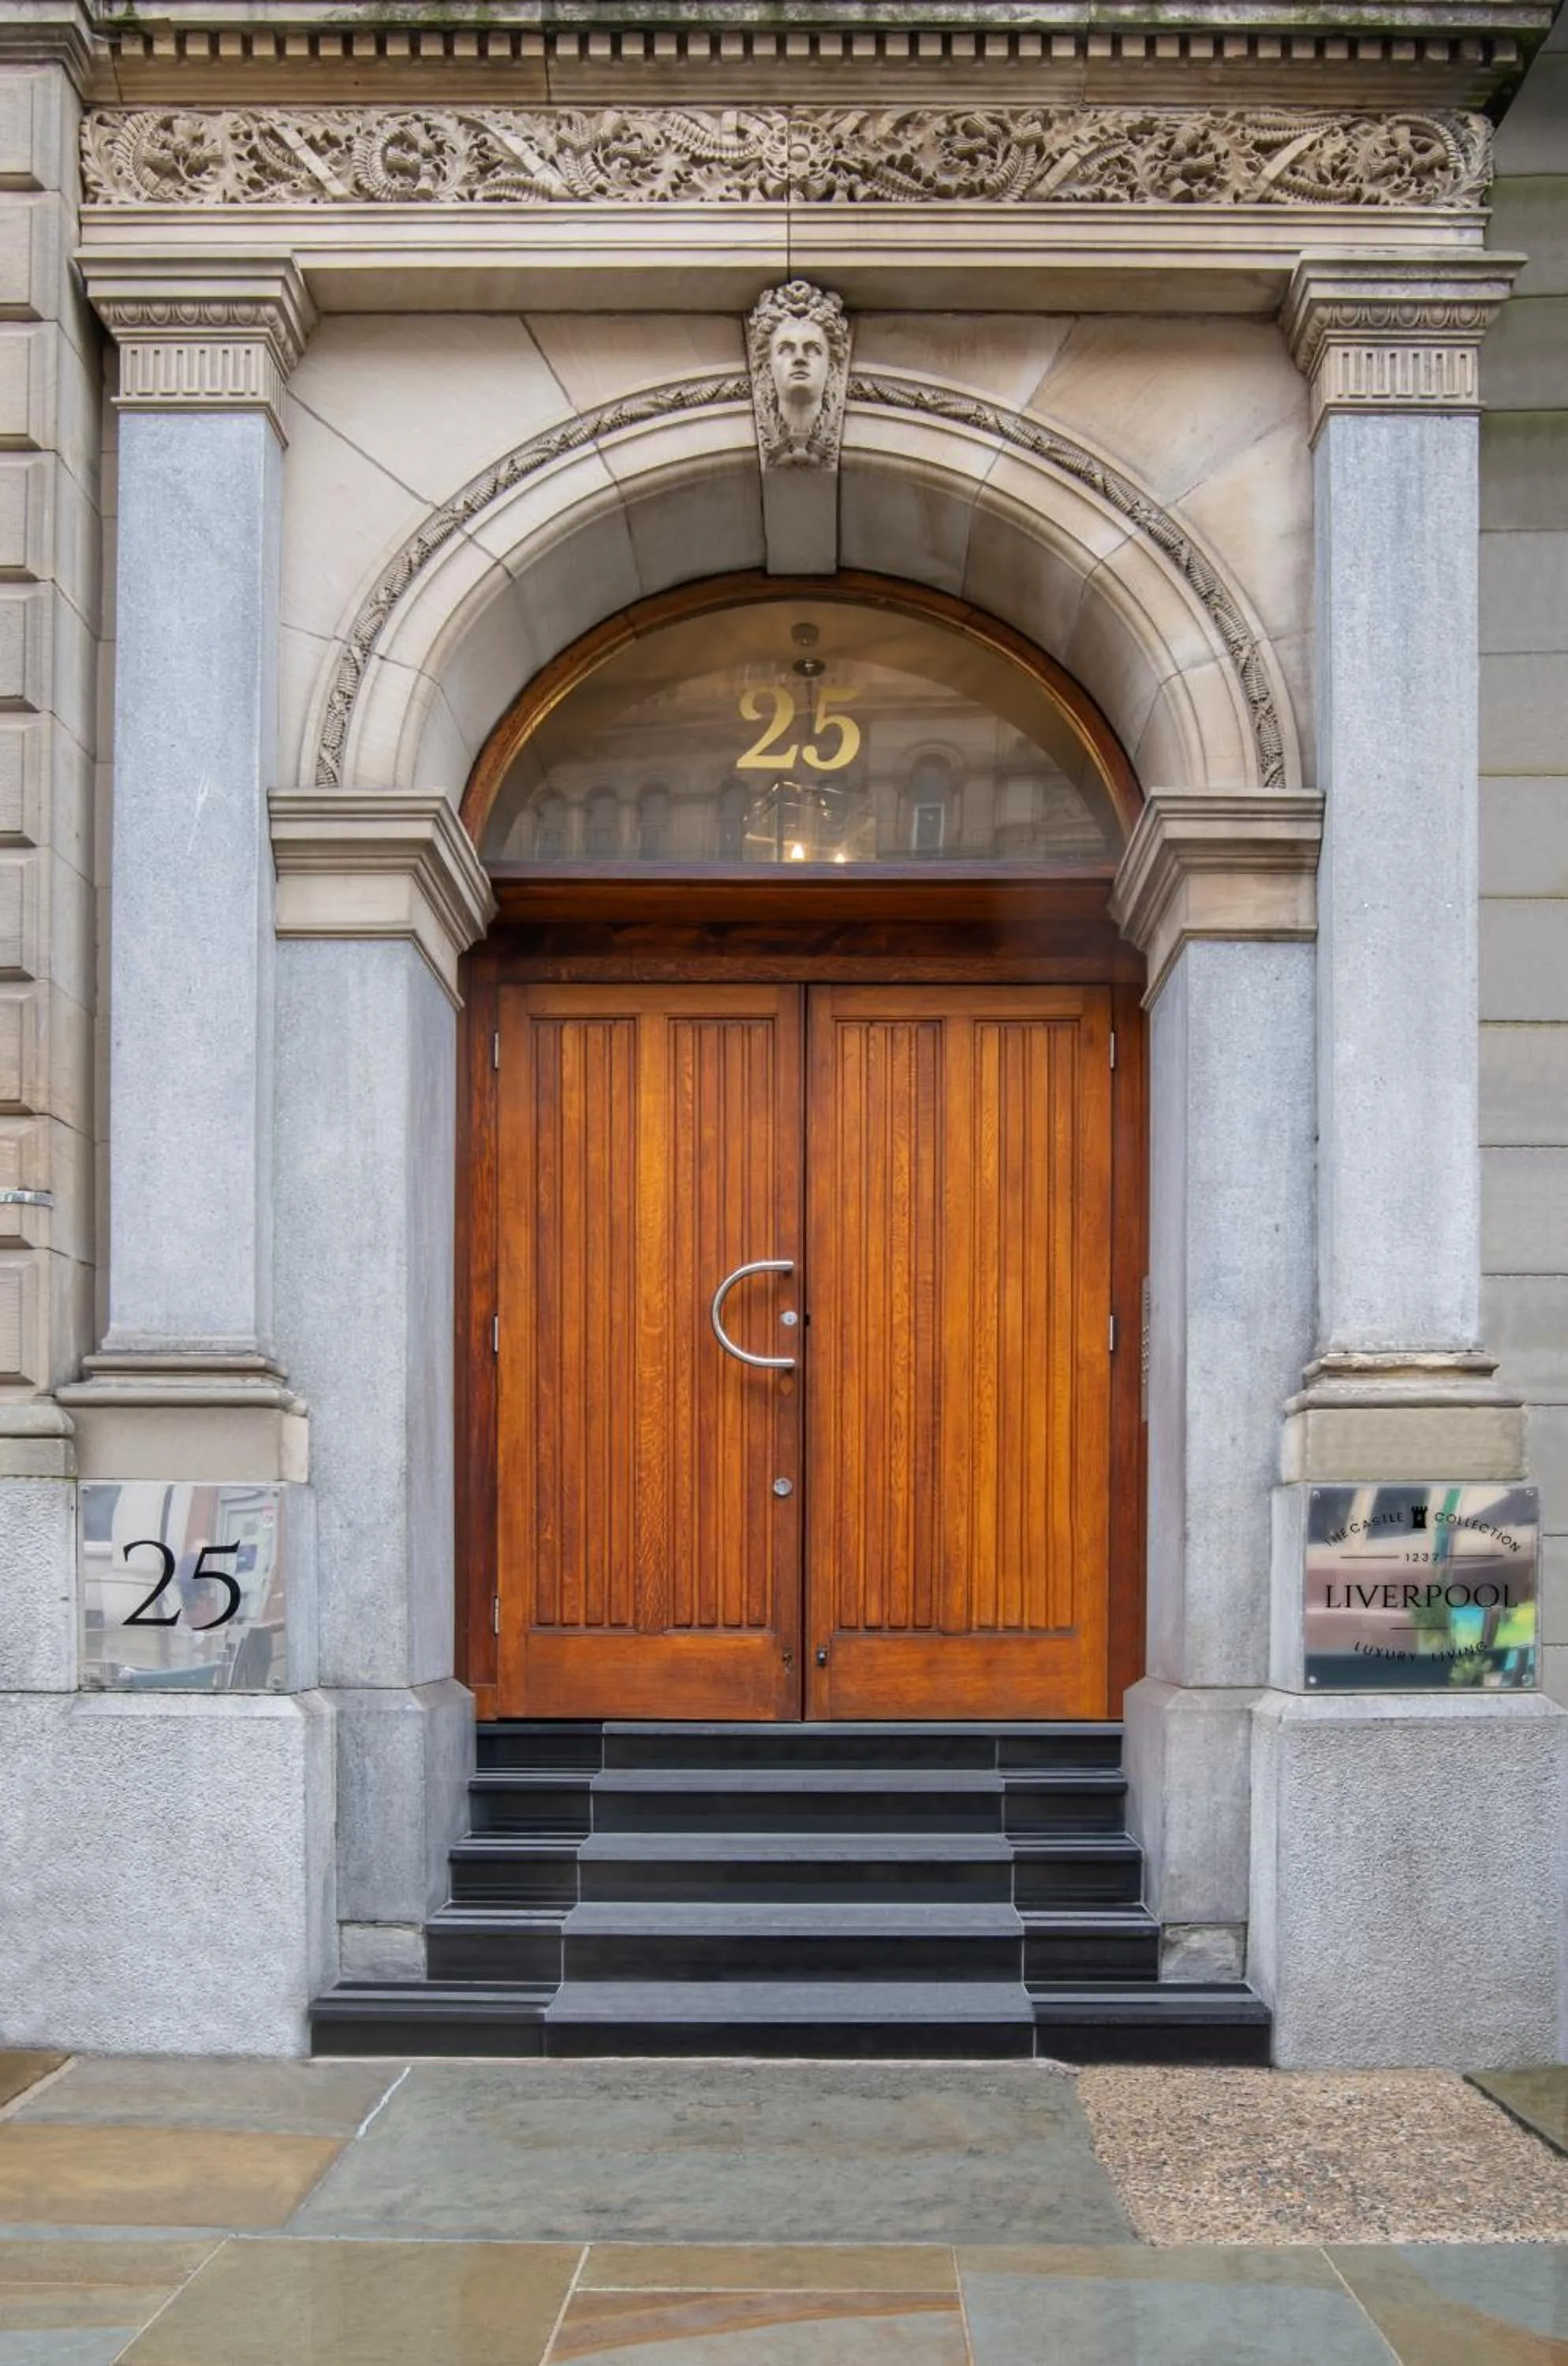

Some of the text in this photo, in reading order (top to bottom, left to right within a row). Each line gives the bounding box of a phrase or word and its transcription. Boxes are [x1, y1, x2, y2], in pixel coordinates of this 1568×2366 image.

[736, 685, 863, 770] 25
[1324, 1512, 1521, 1552] THE CASTLE COLLECTION
[121, 1539, 241, 1630] 25
[1325, 1584, 1518, 1609] LIVERPOOL
[1353, 1640, 1488, 1662] LUXURY LIVING
